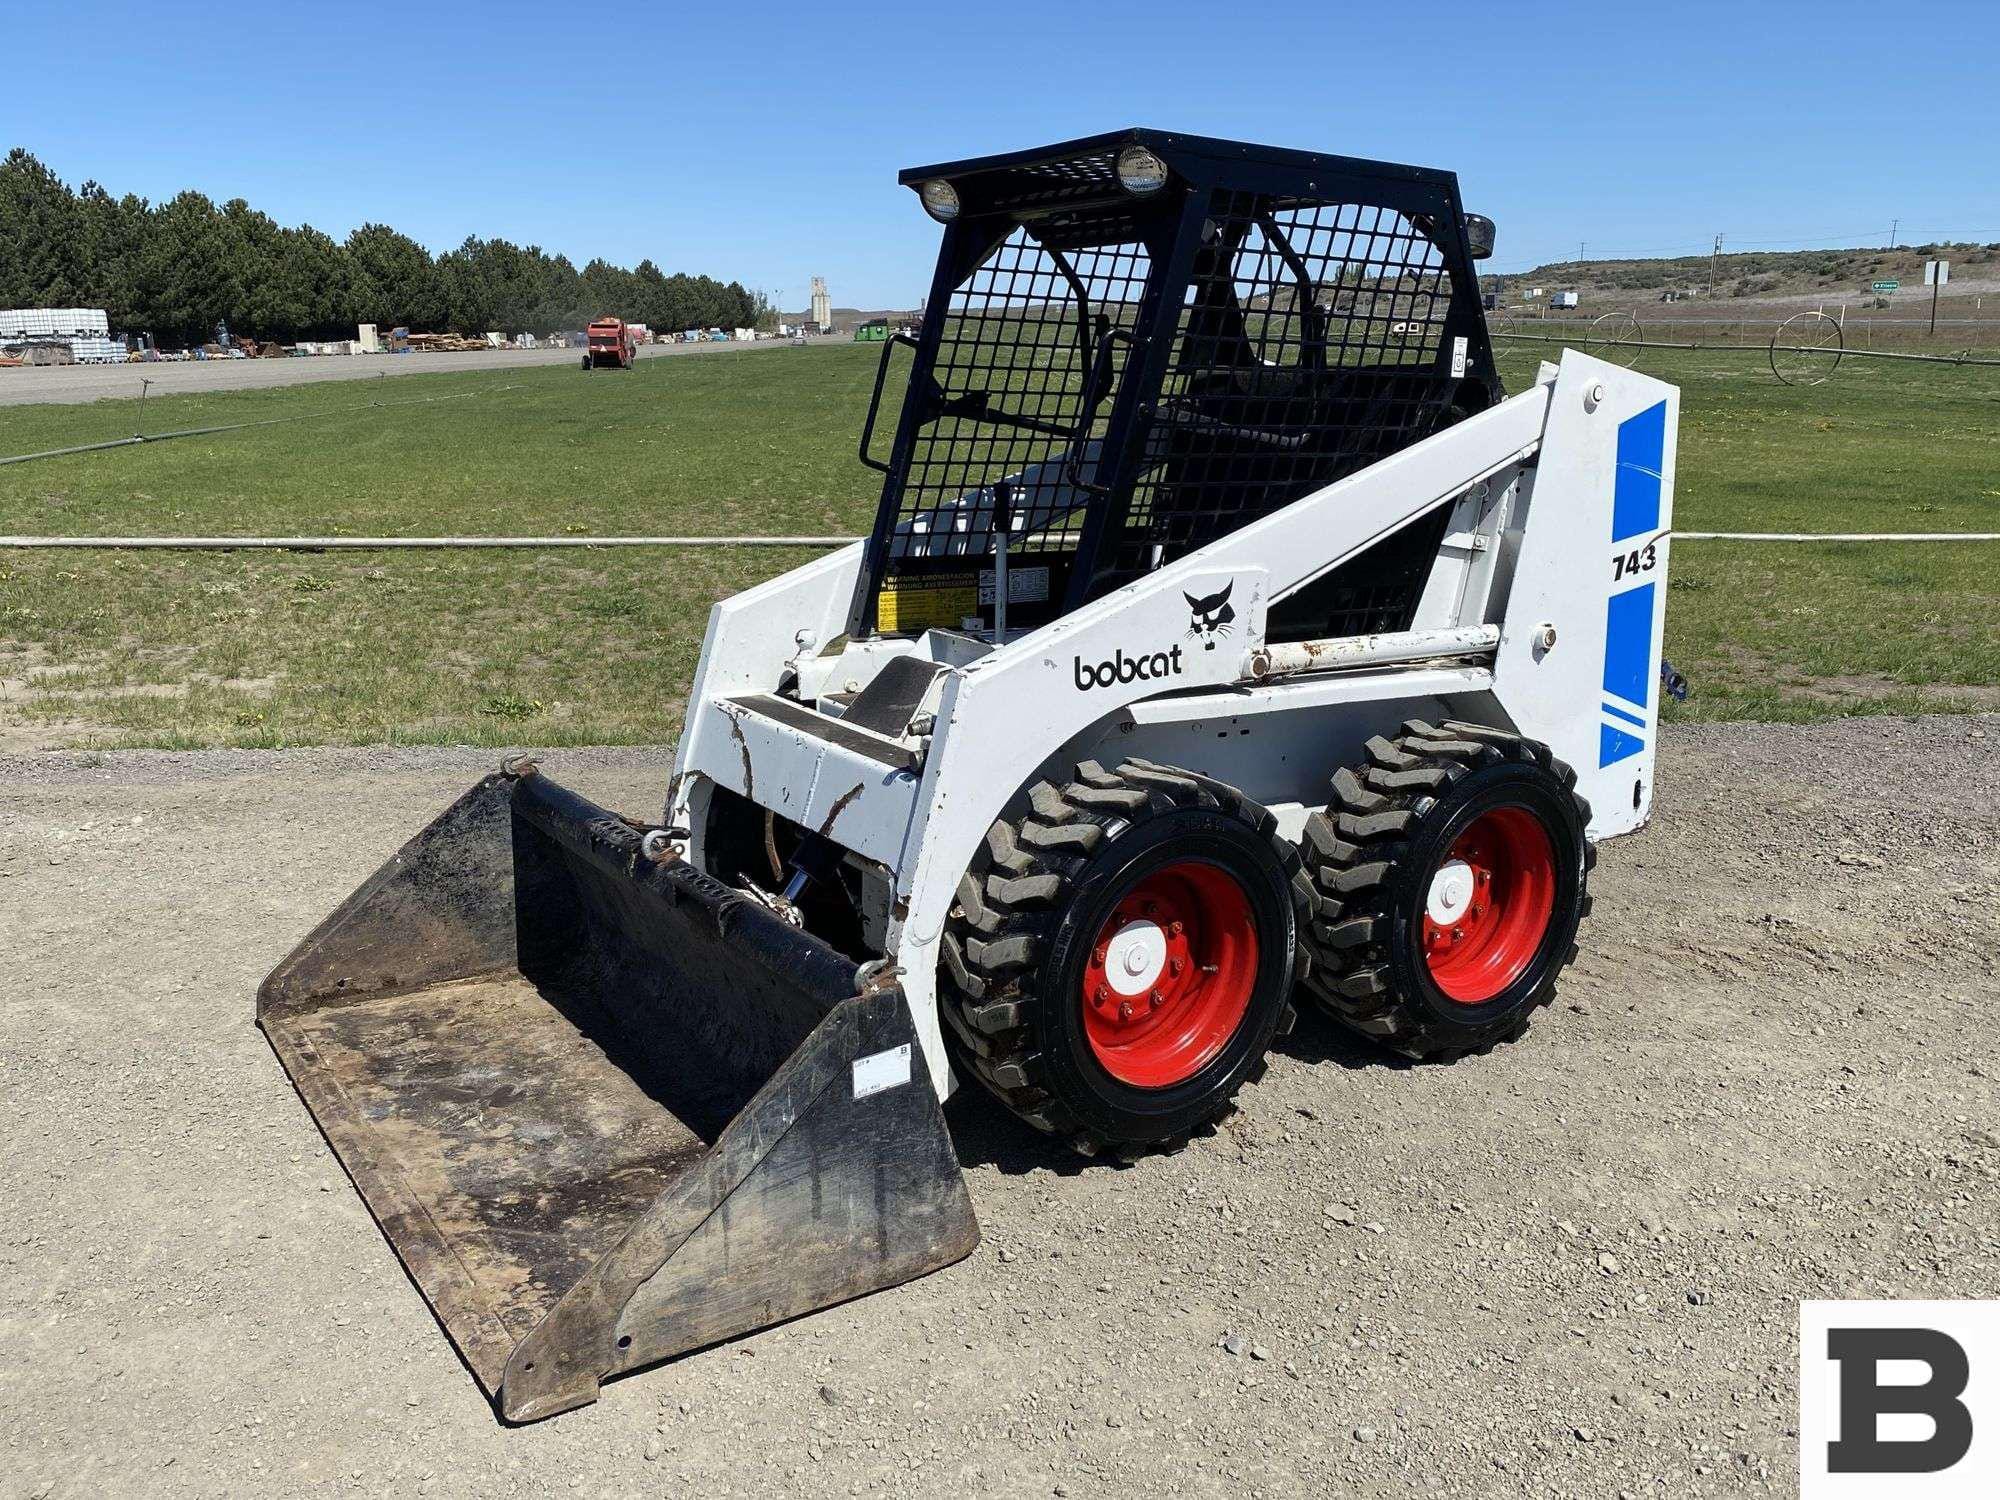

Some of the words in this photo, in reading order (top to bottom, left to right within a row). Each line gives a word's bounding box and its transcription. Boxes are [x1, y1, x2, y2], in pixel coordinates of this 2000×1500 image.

[1612, 544, 1656, 582] 743
[886, 582, 922, 591] WARNING
[1074, 644, 1182, 691] bobcat
